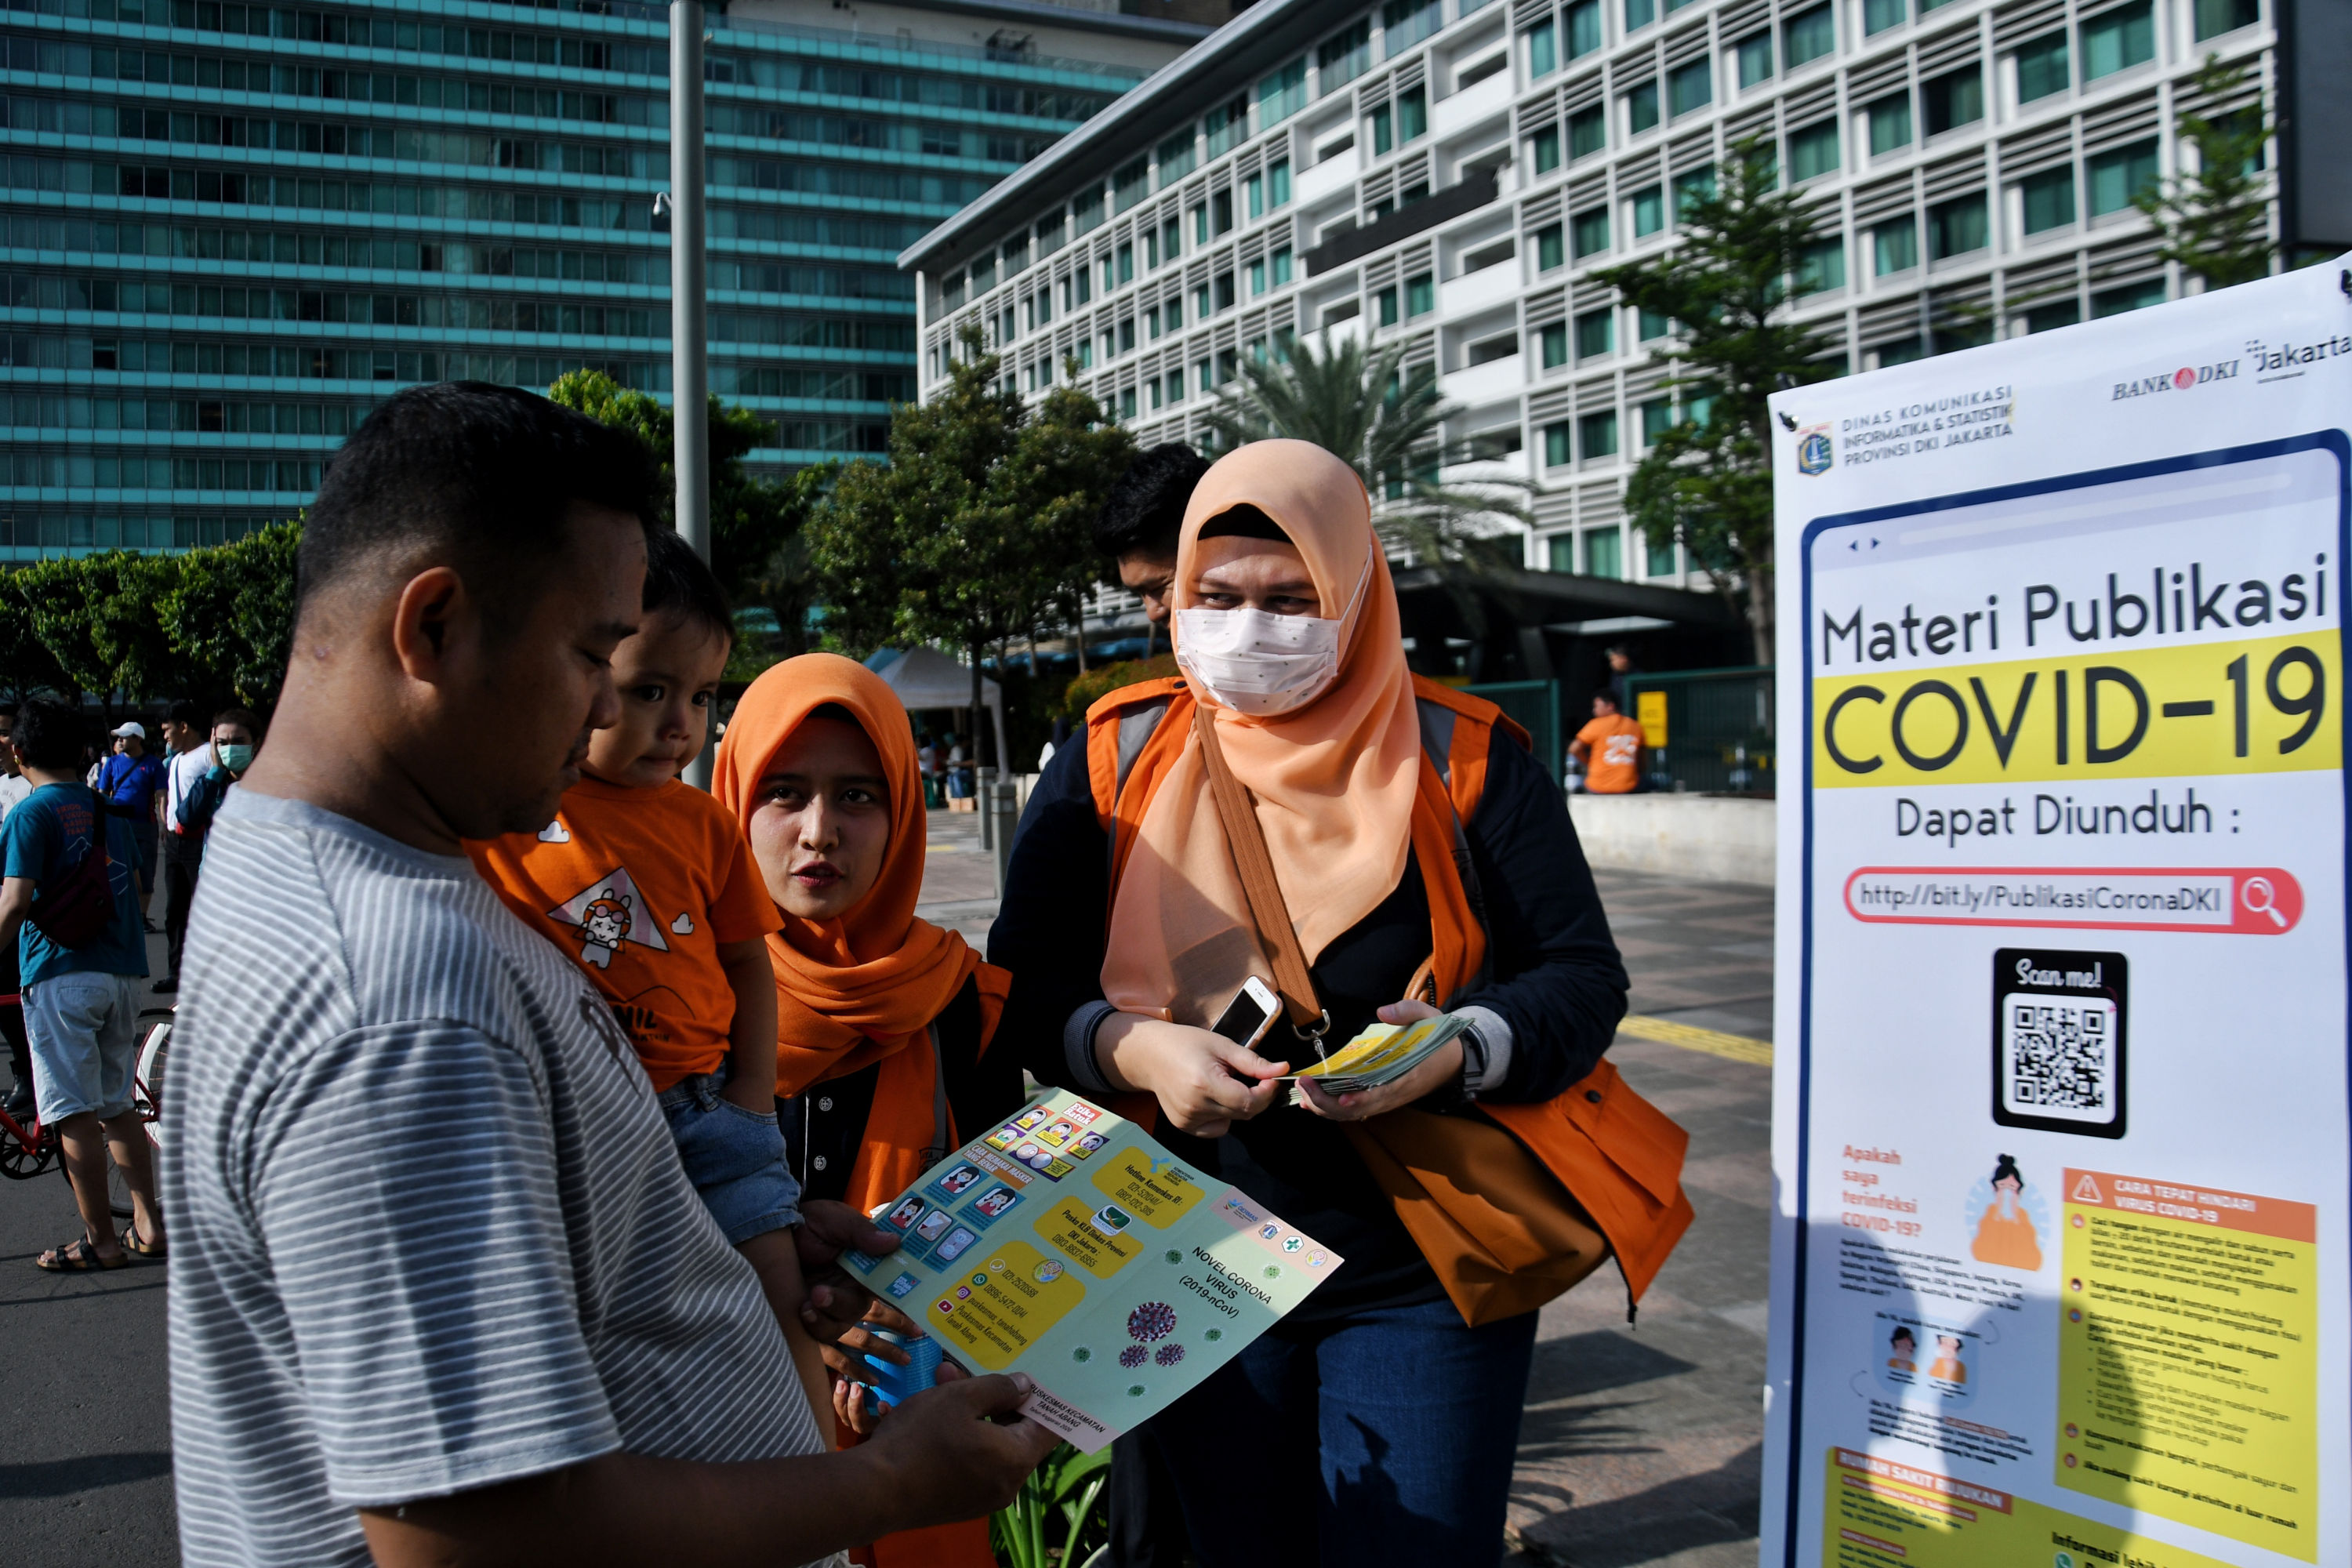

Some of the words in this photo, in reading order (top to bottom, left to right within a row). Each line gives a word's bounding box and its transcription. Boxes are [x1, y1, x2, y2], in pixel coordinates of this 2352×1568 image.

[2253, 336, 2352, 372] Jakarta
[2111, 372, 2174, 401] BANK
[2196, 359, 2241, 384] DKI
[1842, 409, 1893, 432] DINAS
[1899, 385, 2013, 419] KOMUNIKASI
[1843, 421, 1931, 449] INFORMATIKA
[1933, 417, 1944, 431] &
[1946, 402, 2013, 429] STATISTIK
[1844, 442, 1911, 466] PROVINSI
[1914, 436, 1939, 453] DKI
[1944, 423, 2013, 448] JAKARTA
[1823, 593, 1999, 665] Materi
[2025, 552, 2328, 647] Publikasi
[1824, 645, 2325, 774] COVID-19
[1896, 797, 2015, 848] Dapat
[2034, 787, 2212, 835] Diunduh
[1860, 882, 2220, 913] http://bit.ly/PublikasiCoronaDKI
[2015, 958, 2065, 986] Scan
[2065, 961, 2102, 988] me!
[1063, 1107, 1091, 1125] Batuk
[1072, 1102, 1095, 1119] Etika
[964, 1150, 982, 1162] YANG
[978, 1160, 999, 1174] BENAR
[971, 1145, 987, 1157] CARA
[985, 1152, 1012, 1174] MEMAKAI
[1008, 1166, 1034, 1185] MASKER
[1842, 1144, 1901, 1165] Apakah
[1124, 1164, 1145, 1182] Hotline
[1145, 1179, 1173, 1200] Kemenkes
[1842, 1169, 1878, 1187] saya
[2114, 1179, 2153, 1196] CARA
[2153, 1185, 2195, 1202] TEPAT
[1842, 1190, 1918, 1214] terinfeksi
[2114, 1196, 2156, 1213] VIRUS
[2157, 1202, 2220, 1223] COVID-19
[1062, 1210, 1080, 1225] Posko
[1078, 1221, 1091, 1232] KLB
[1104, 1240, 1128, 1258] Provinsi
[1842, 1211, 1922, 1237] COVID-19?
[1068, 1230, 1080, 1240] DKI
[1076, 1238, 1098, 1254] Jakarta
[1192, 1247, 1226, 1276] NOVEL
[1227, 1272, 1272, 1305] CORONA
[1206, 1273, 1238, 1299] VIRUS
[1179, 1275, 1240, 1319] (2019-nCoV)
[946, 1314, 963, 1330] Tanah
[960, 1328, 977, 1344] Abang
[956, 1305, 985, 1332] Puskesmas
[982, 1328, 1012, 1354] Kecamatan
[1030, 1384, 1067, 1410] PUSKESMAS
[1065, 1407, 1105, 1433] KECAMATAN
[1036, 1400, 1058, 1416] TANAH
[1056, 1412, 1081, 1428] ABANG
[1059, 1423, 1073, 1432] 2020
[1838, 1451, 1891, 1477] RUMAH
[1892, 1465, 1934, 1488] SAKIT
[2052, 1531, 2120, 1565] Informasi
